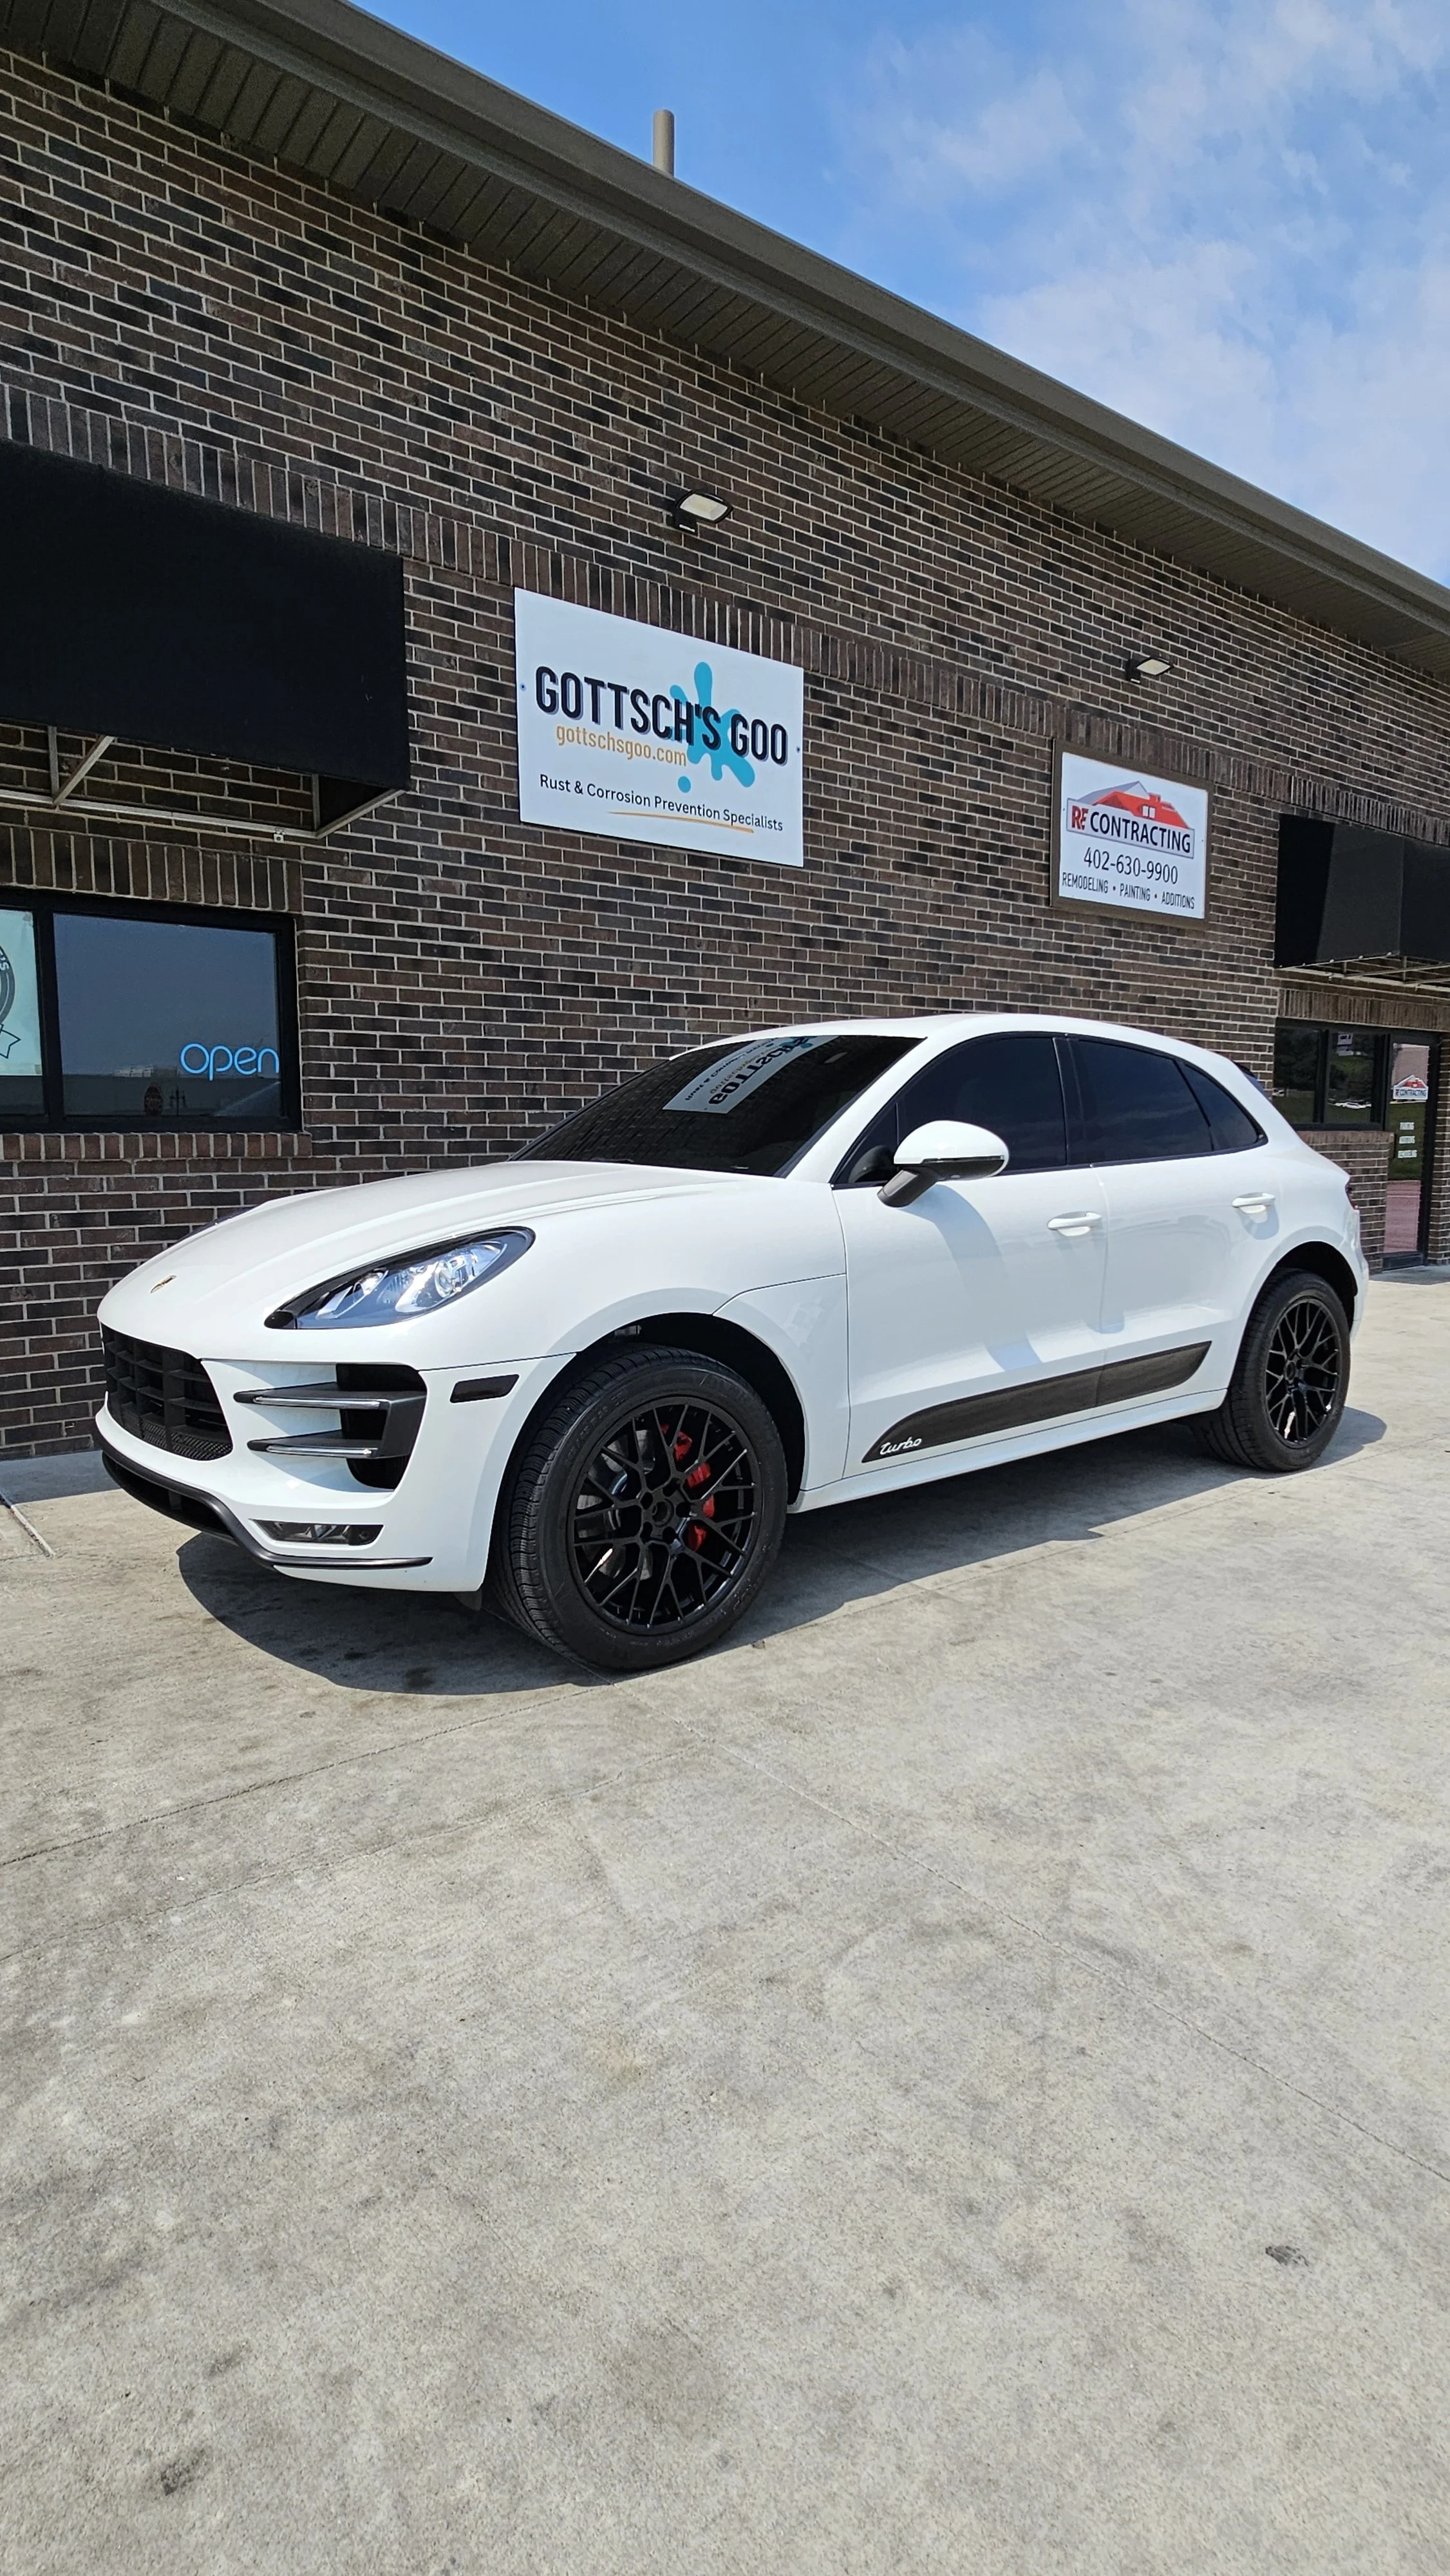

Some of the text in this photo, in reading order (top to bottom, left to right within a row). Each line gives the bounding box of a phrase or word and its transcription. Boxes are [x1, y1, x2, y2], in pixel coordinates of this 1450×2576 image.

[536, 666, 788, 766] GOTTSCH'S GOO
[556, 725, 687, 766] gottschsgoo.com
[540, 774, 783, 831] Rust & Corrosion Prevention Specialists
[1090, 811, 1191, 853] CONTRACTING
[1084, 847, 1178, 884] 402-630-9900
[1062, 871, 1195, 909] REMODELING PAINTING ADDITIONS
[880, 1437, 922, 1455] turbo
